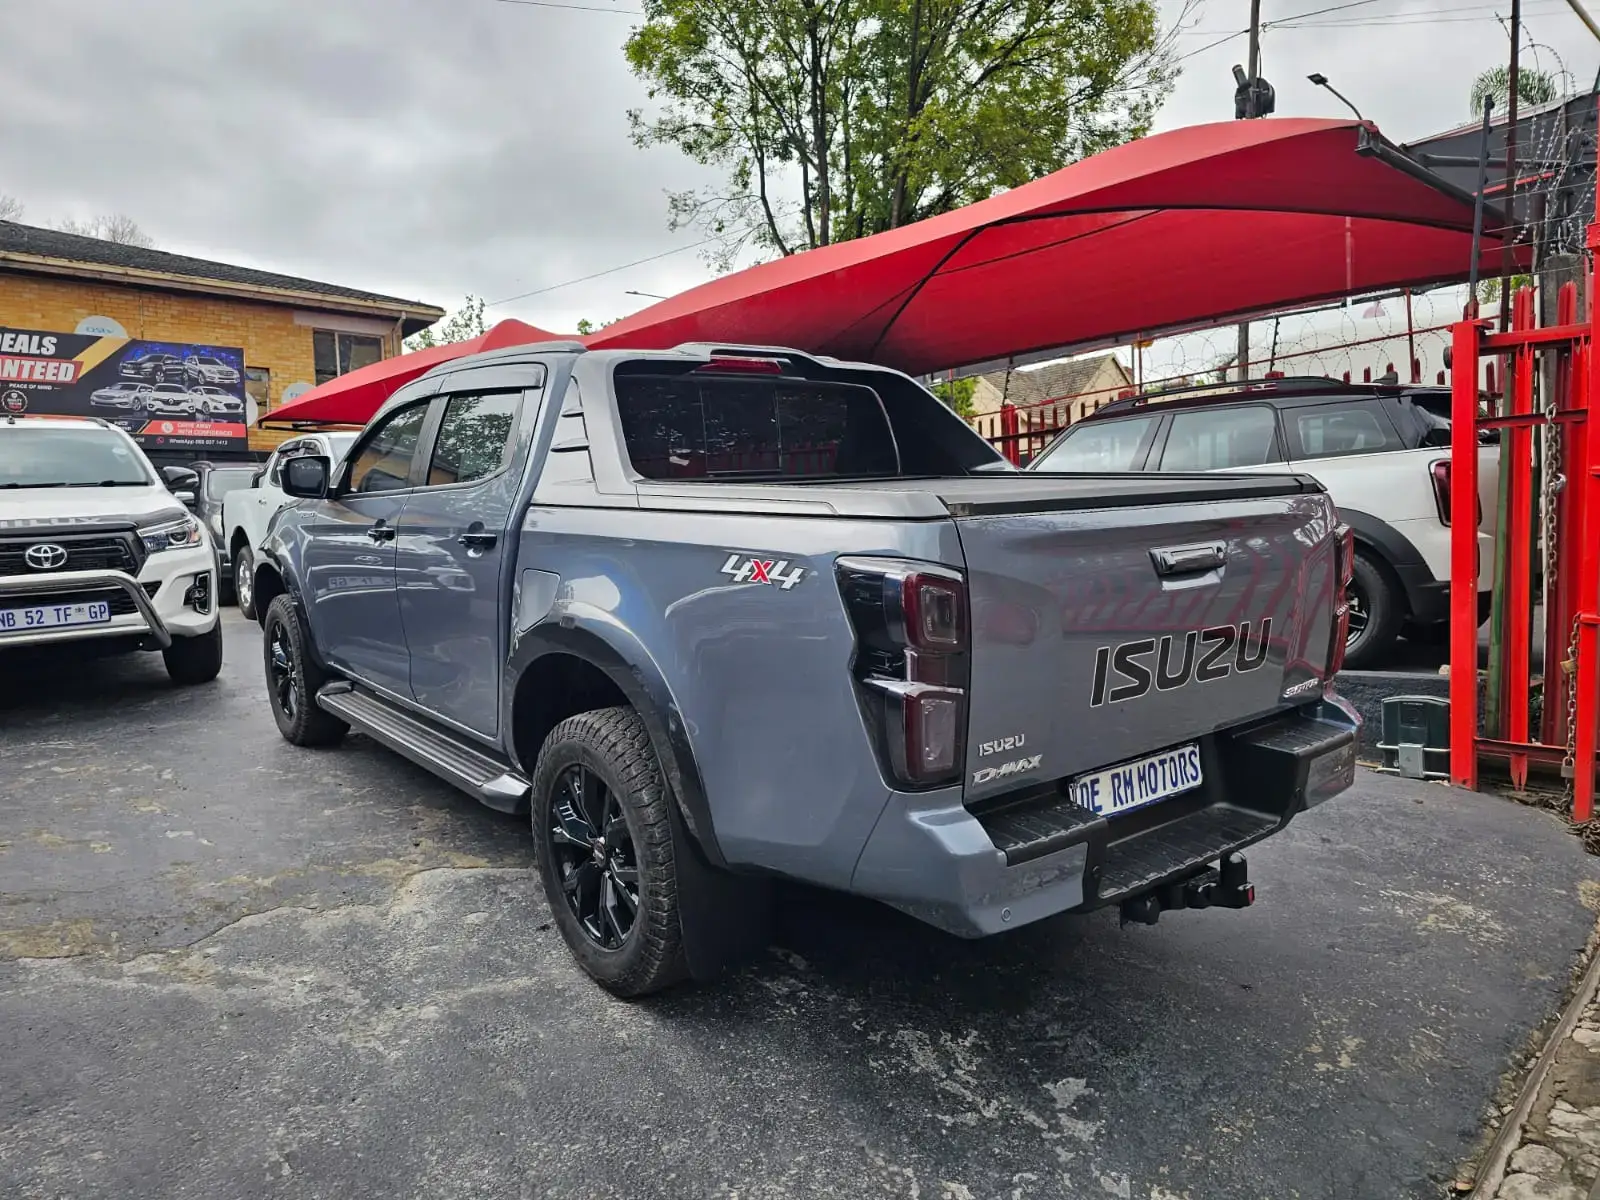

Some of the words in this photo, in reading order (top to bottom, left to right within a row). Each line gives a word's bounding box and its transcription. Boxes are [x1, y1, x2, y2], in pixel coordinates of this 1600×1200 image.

[0, 333, 57, 355] EALS
[0, 358, 75, 382] NTEED
[25, 610, 45, 625] 52
[53, 606, 72, 623] TF
[88, 604, 107, 620] GP
[1090, 617, 1273, 708] ISUZU
[979, 733, 1025, 757] ISUZU
[1110, 768, 1135, 808] RM
[1137, 750, 1199, 799] MOTORS
